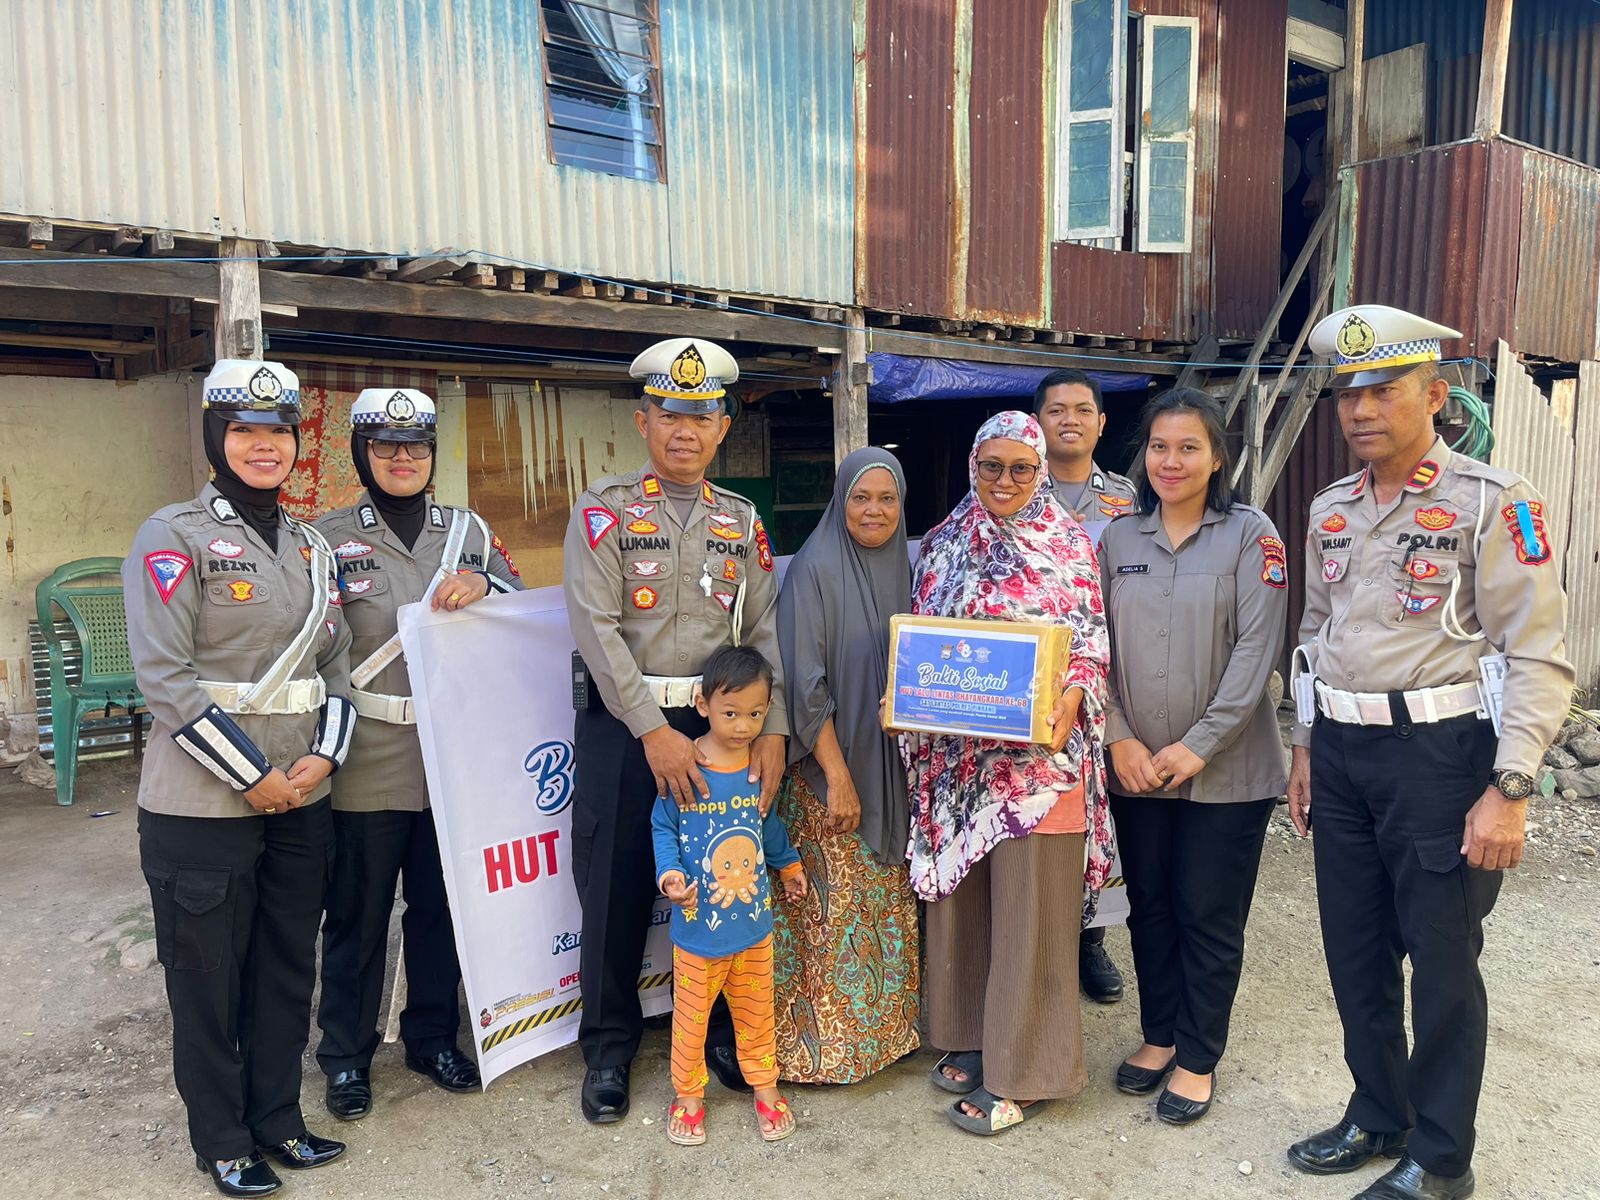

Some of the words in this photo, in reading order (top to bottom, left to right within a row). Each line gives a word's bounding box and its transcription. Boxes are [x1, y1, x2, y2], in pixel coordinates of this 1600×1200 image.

[619, 536, 670, 551] LUKMAN
[706, 539, 747, 559] POLRI
[1397, 533, 1458, 551] POLRI
[208, 559, 258, 573] REZKY
[459, 553, 482, 567] LRI
[917, 662, 961, 687] Bakti
[959, 667, 1009, 692] Sosial
[932, 689, 955, 700] LINTAS
[955, 692, 1005, 706] BHAYANGKARA
[523, 739, 577, 815] B
[483, 829, 560, 894] HUT
